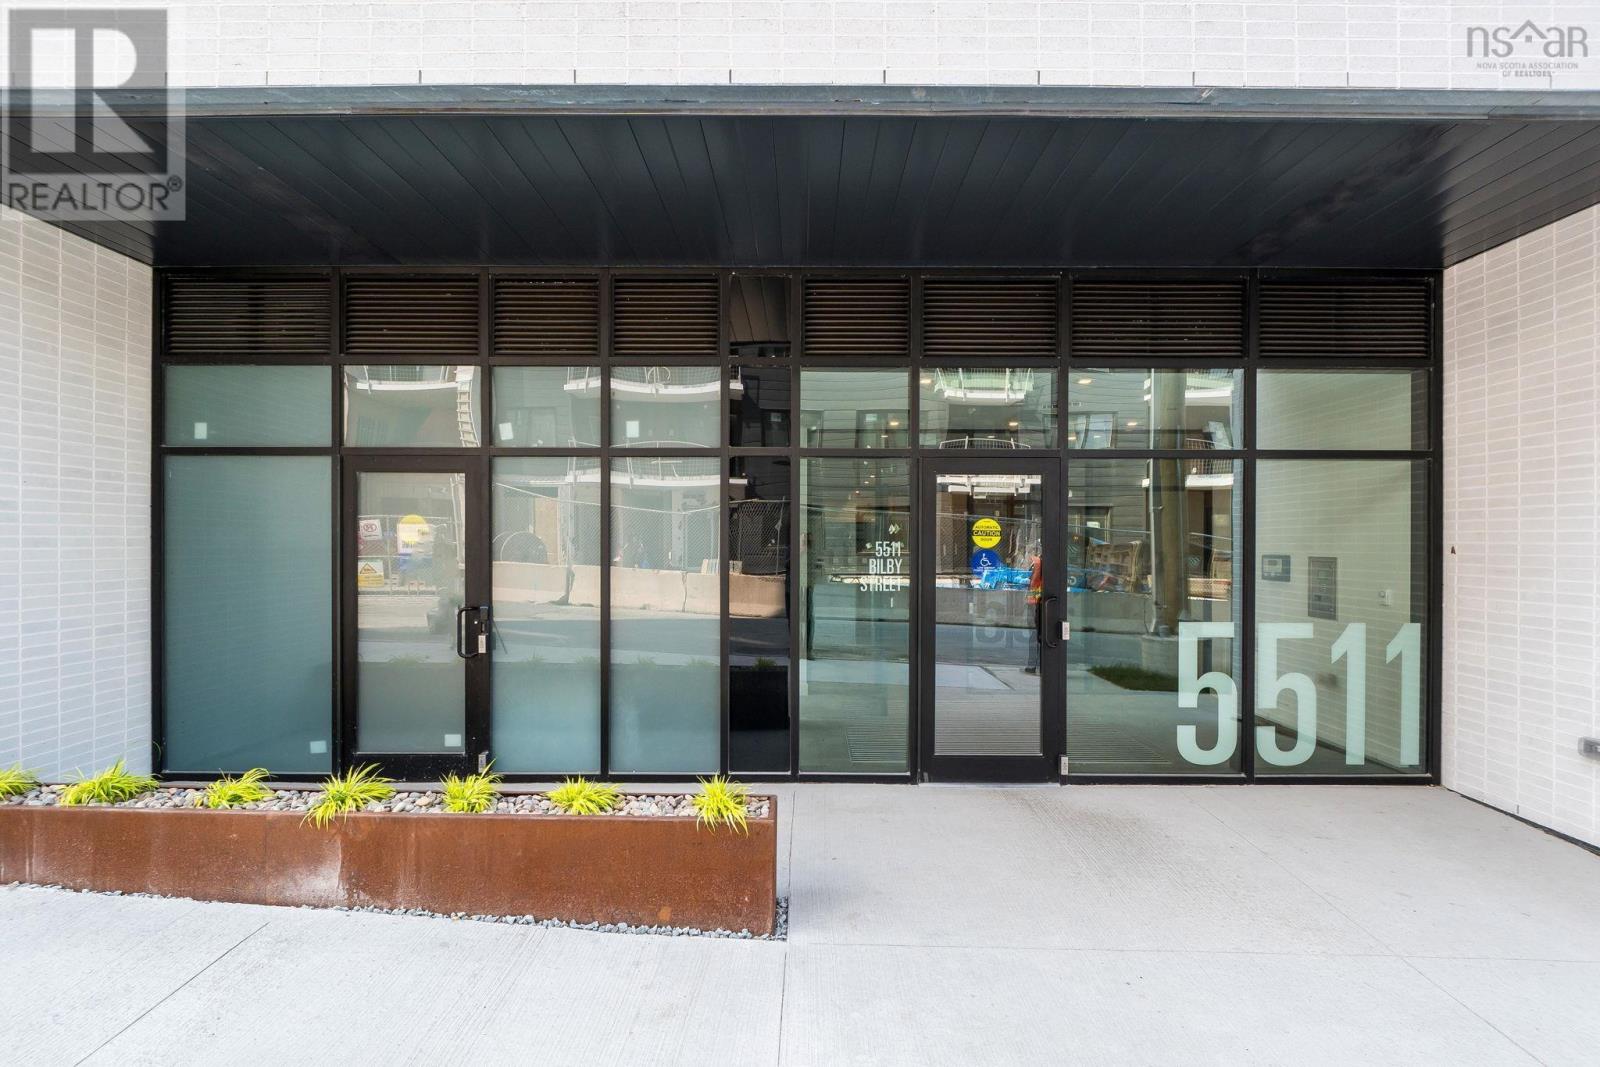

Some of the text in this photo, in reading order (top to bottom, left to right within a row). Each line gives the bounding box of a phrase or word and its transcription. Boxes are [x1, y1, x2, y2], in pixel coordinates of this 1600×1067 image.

[875, 541, 901, 557] 5511
[869, 558, 903, 574] BILBY
[860, 575, 901, 592] STREET
[1177, 622, 1421, 766] 5511
